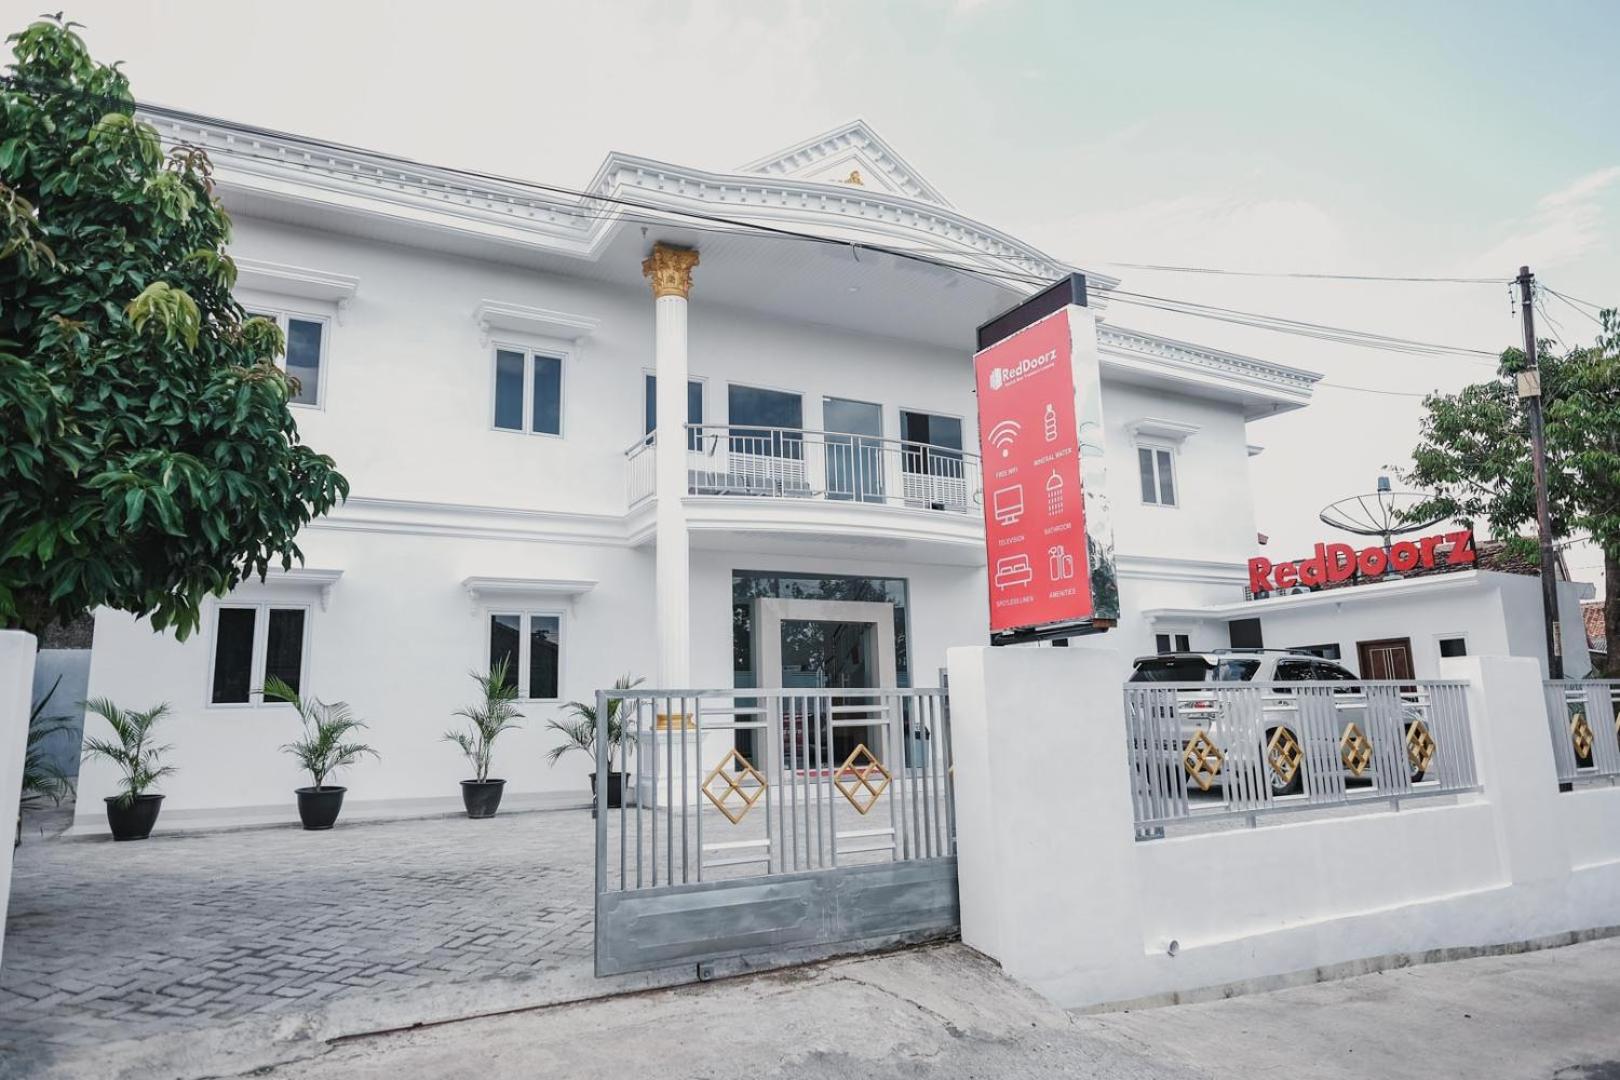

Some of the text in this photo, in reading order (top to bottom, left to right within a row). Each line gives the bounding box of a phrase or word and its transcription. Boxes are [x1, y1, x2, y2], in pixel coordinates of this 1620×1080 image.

[1002, 349, 1056, 381] RedDoorz
[998, 535, 1024, 546] TELEVISION
[1248, 530, 1476, 593] RedDoorz
